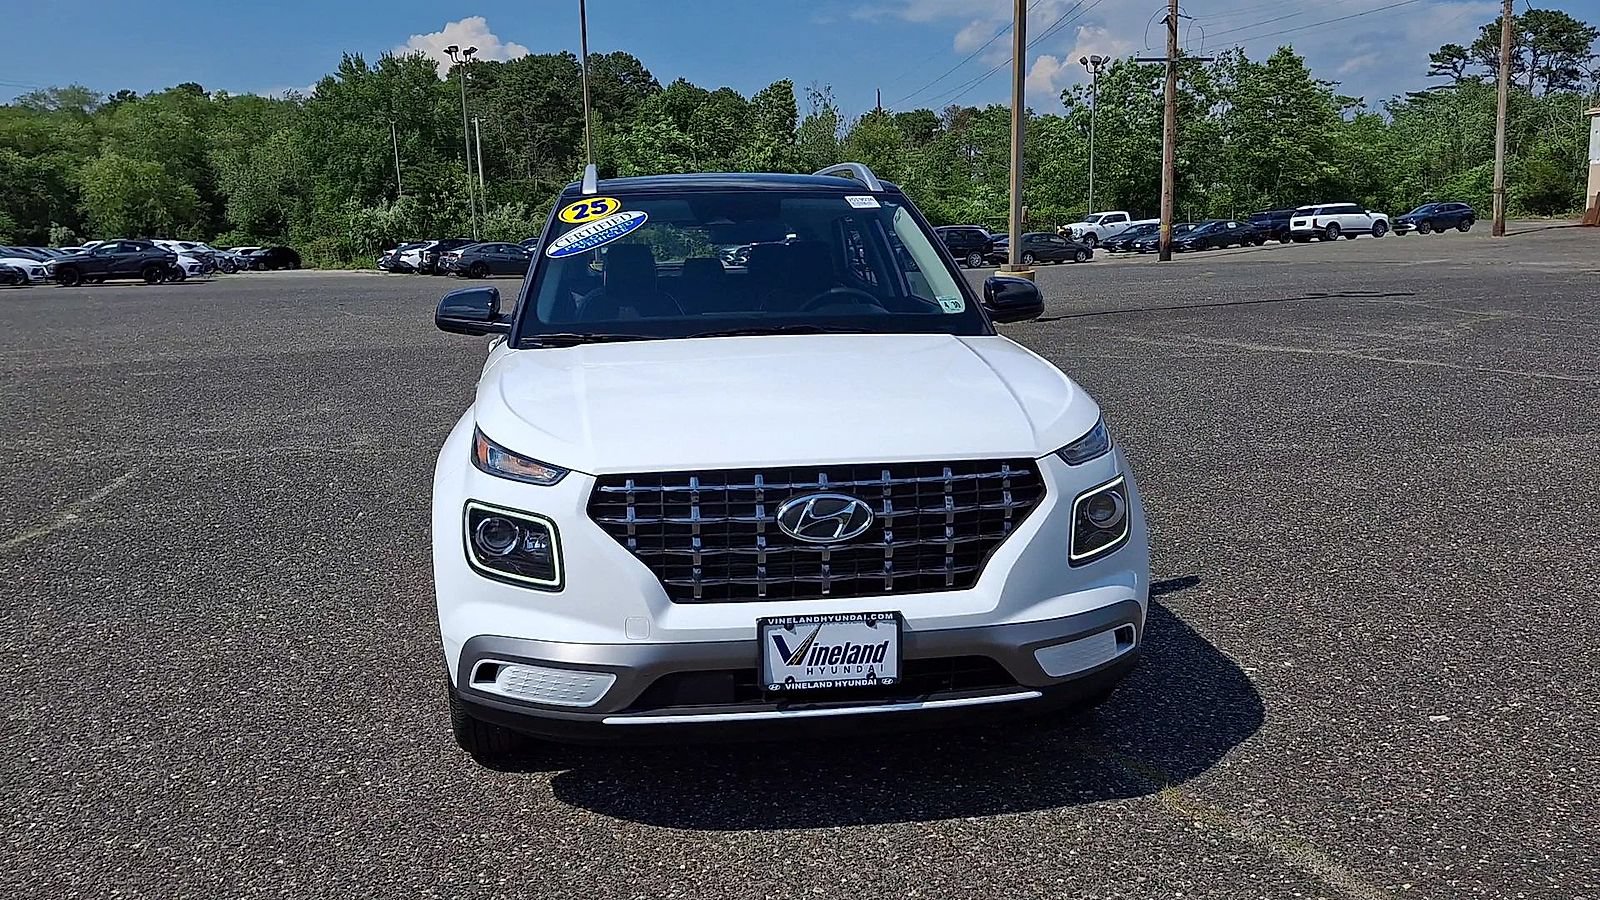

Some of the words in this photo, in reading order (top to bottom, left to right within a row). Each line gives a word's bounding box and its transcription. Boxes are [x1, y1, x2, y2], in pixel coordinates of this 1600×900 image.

[571, 199, 609, 220] 25
[555, 213, 632, 248] CERTIFIED
[767, 613, 894, 625] VINELANDHYUNDAI.COM
[771, 622, 890, 667] Vineland
[806, 664, 884, 676] HYUNDAI
[785, 681, 833, 690] VINELAND
[834, 679, 878, 689] HYUNDAI
